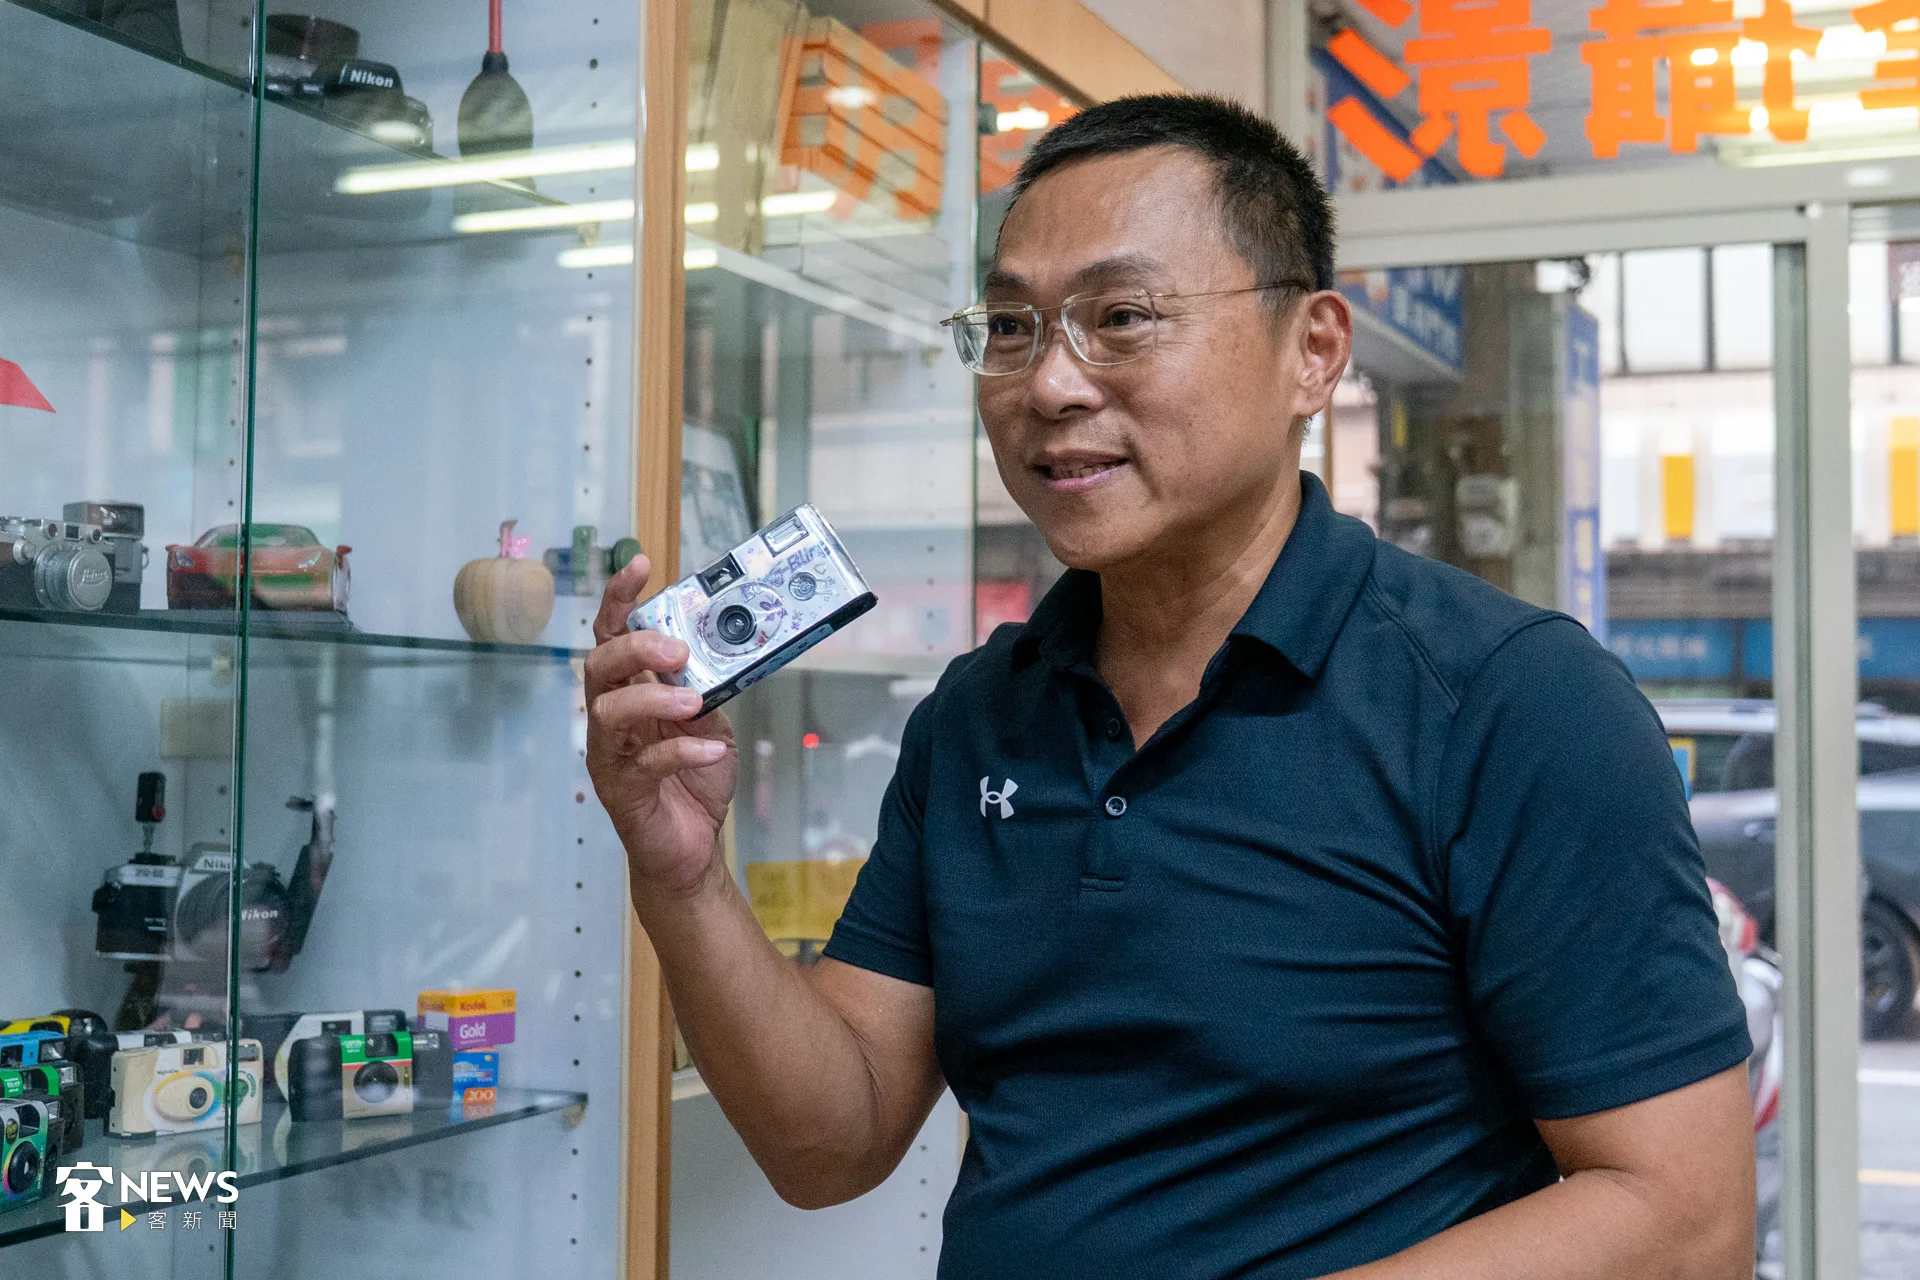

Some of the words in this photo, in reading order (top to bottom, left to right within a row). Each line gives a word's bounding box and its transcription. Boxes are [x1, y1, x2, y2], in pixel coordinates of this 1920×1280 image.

[350, 68, 394, 88] Nikon
[203, 858, 231, 869] Nik
[459, 1000, 488, 1011] Kodak
[459, 1021, 487, 1039] Gold
[467, 1089, 494, 1101] 200
